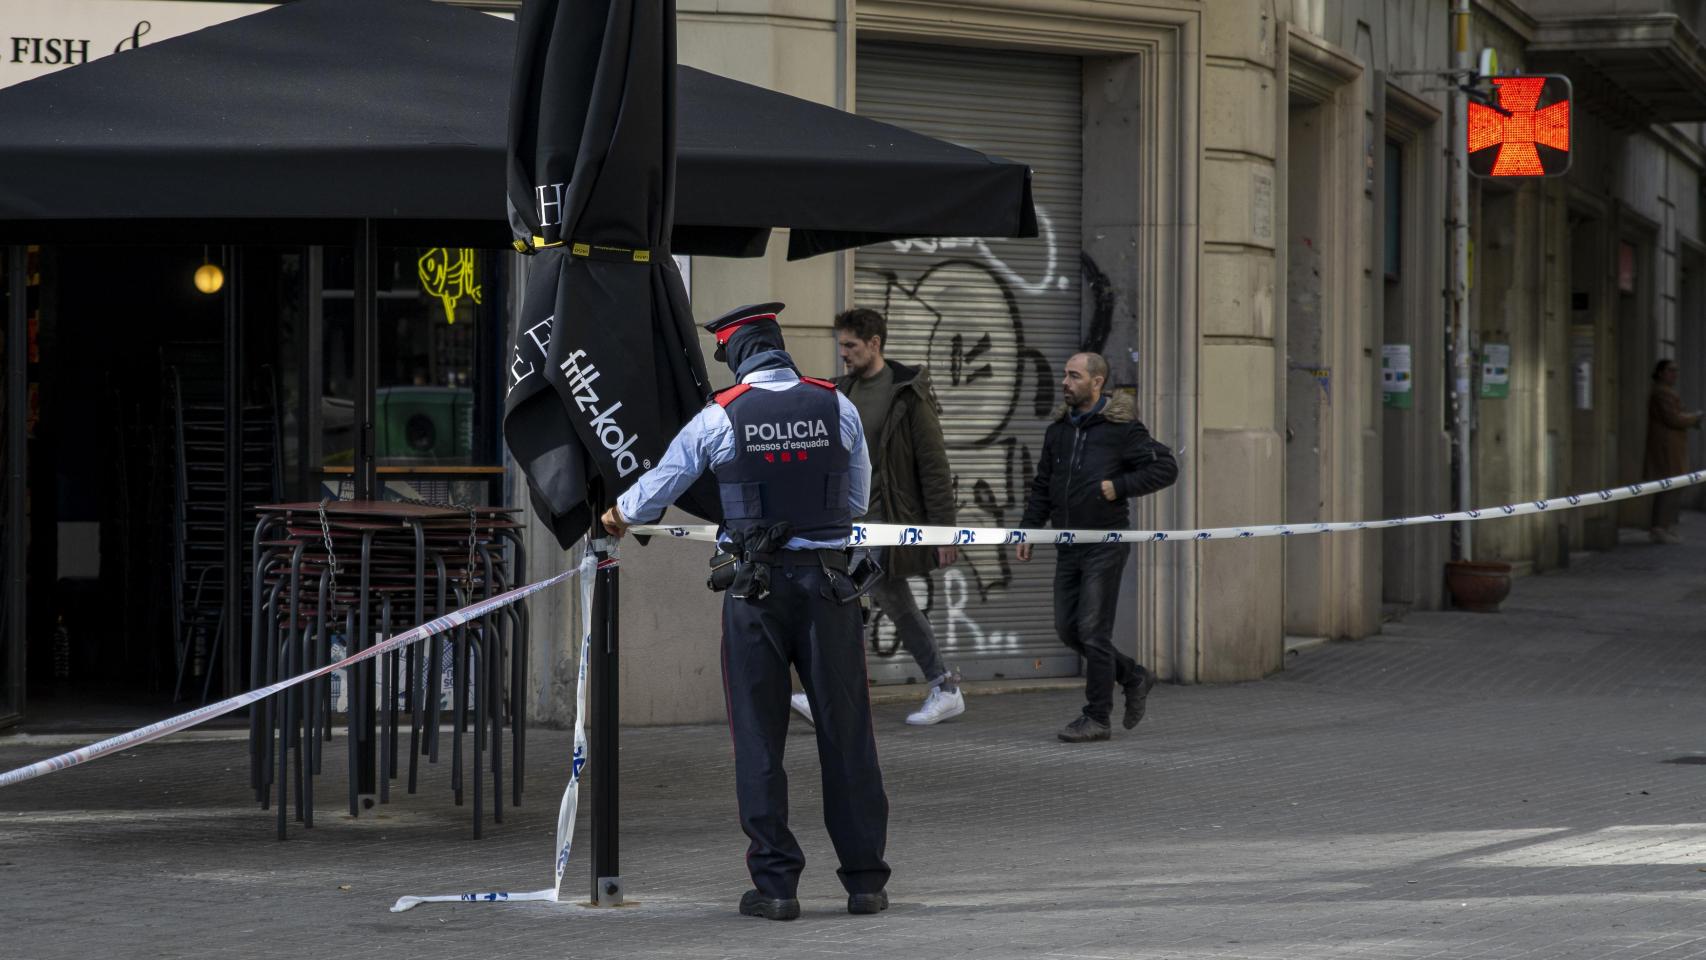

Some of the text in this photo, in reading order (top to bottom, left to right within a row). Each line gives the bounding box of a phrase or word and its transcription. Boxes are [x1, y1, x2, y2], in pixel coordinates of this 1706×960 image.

[10, 36, 91, 64] FISH
[535, 183, 565, 227] H
[560, 349, 639, 478] fritz-kola
[745, 419, 829, 442] POLICIA
[746, 438, 830, 452] mossos d'esquadra
